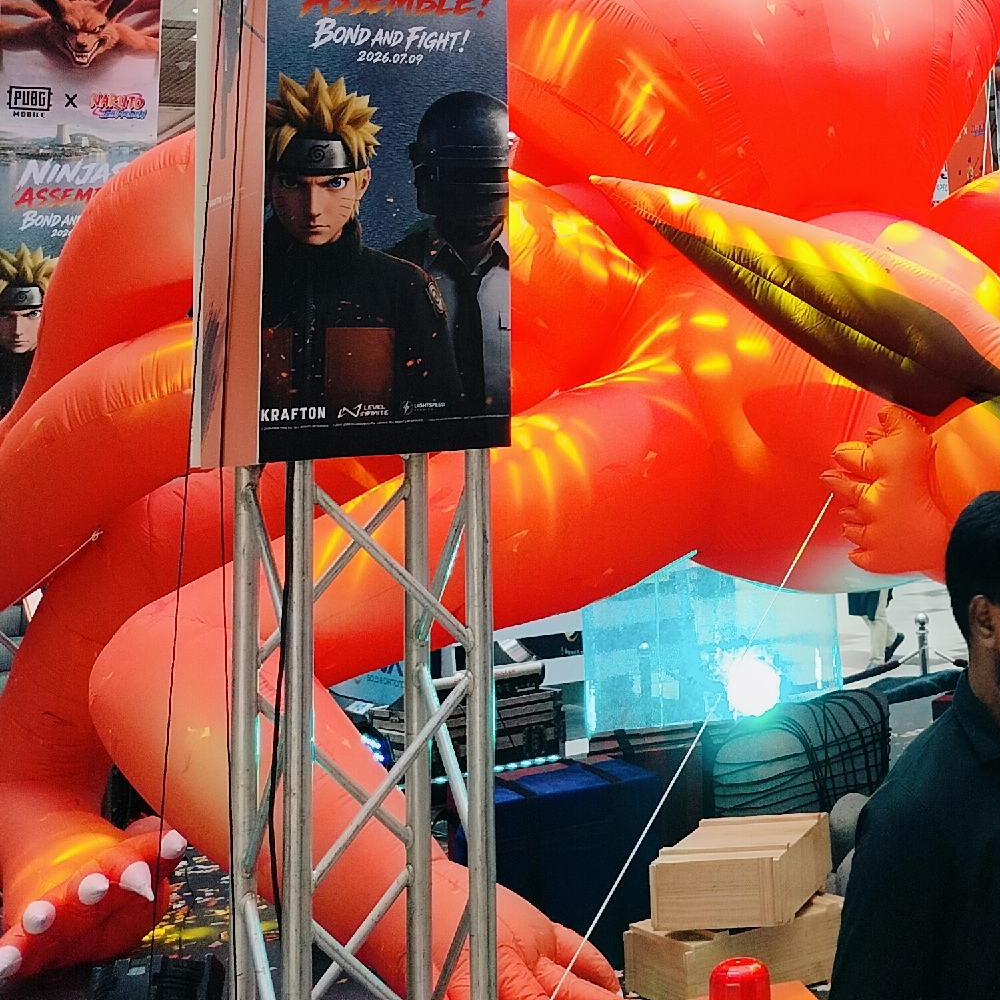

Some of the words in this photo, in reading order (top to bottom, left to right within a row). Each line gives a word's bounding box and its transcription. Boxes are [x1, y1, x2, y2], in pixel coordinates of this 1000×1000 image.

[308, 16, 371, 50] BOND
[370, 28, 405, 48] AND
[405, 25, 471, 54] FIGHT!
[356, 50, 424, 66] 2026.07.09
[13, 90, 47, 108] PUBG
[18, 209, 61, 232] BOND
[260, 405, 327, 423] KRAFTON
